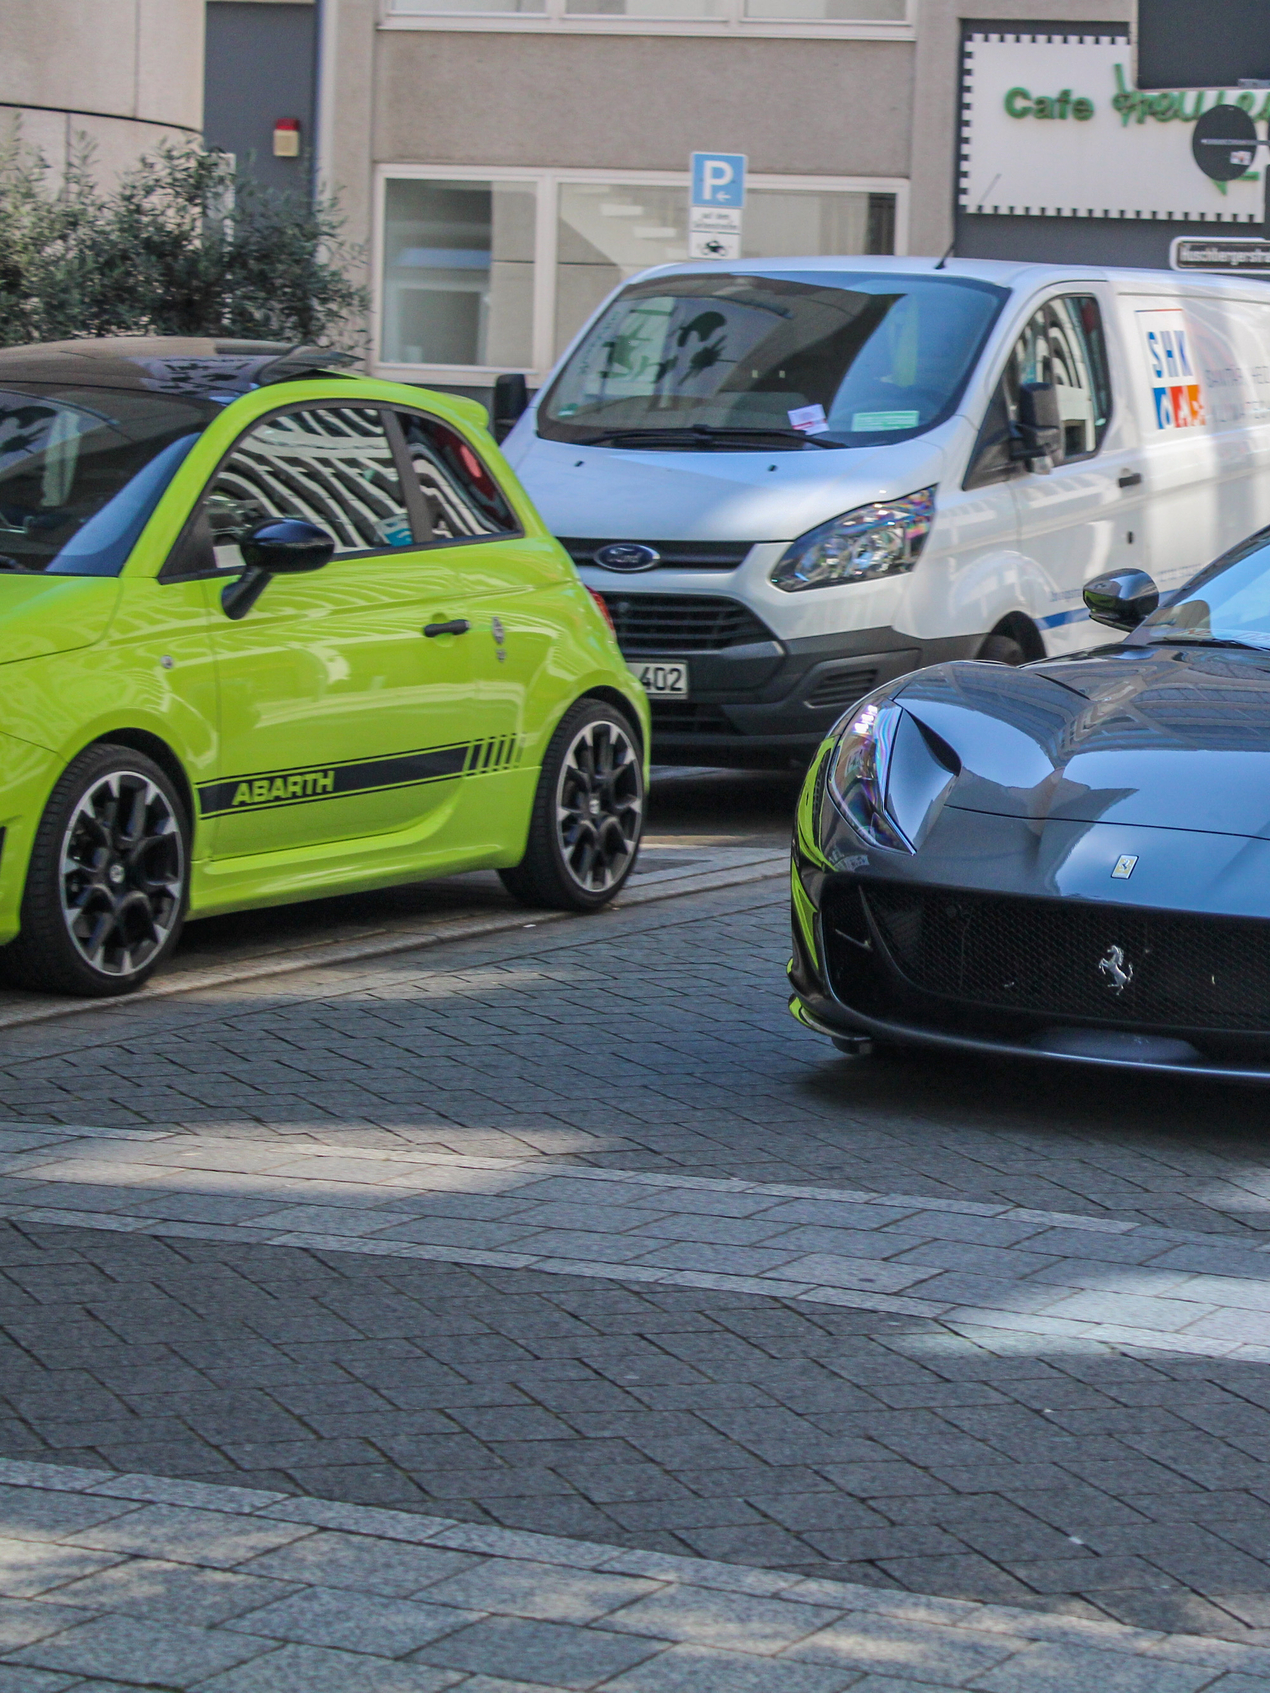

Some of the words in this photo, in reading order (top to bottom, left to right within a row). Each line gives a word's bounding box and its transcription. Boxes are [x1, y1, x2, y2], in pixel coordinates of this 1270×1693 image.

[1004, 86, 1095, 121] Cafe
[703, 160, 734, 200] P
[1147, 330, 1194, 379] SHK
[640, 666, 683, 692] 402
[231, 770, 336, 806] ABARTH
